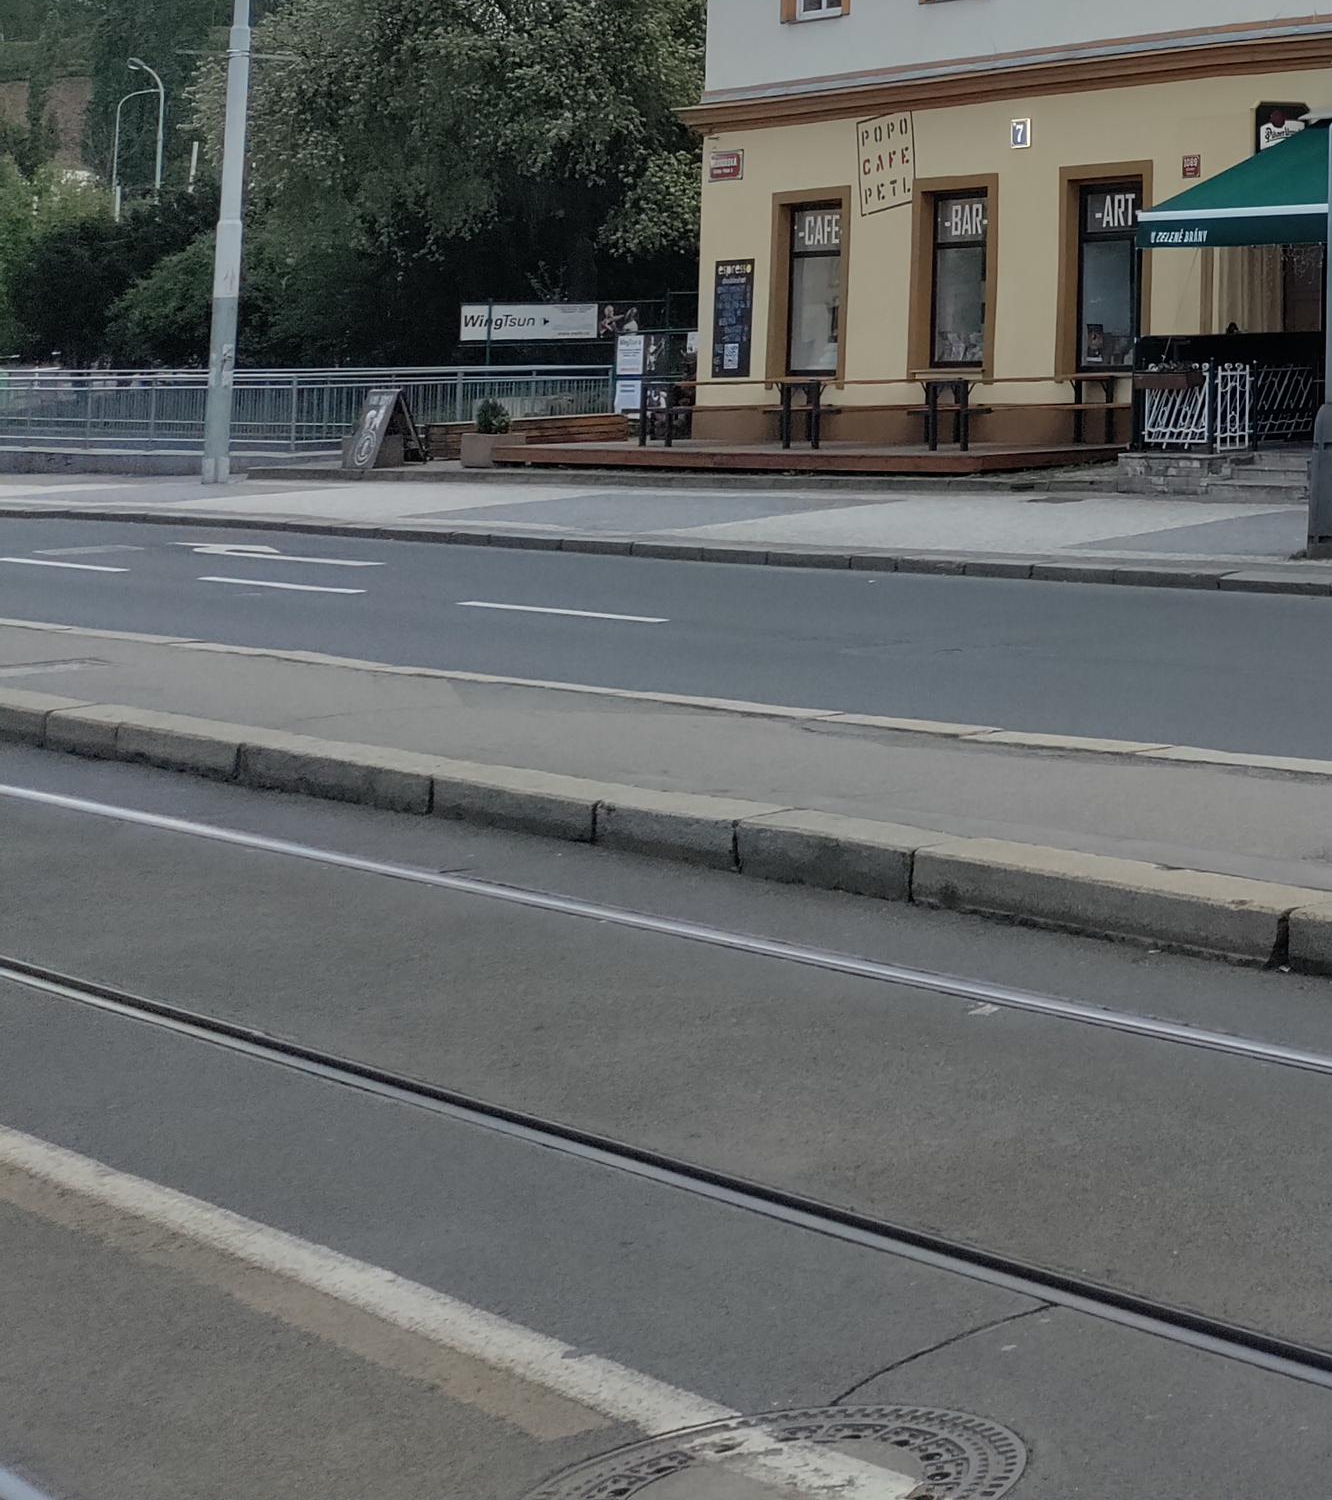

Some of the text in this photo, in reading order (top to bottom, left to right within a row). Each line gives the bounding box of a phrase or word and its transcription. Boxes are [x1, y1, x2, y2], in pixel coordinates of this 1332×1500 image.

[861, 117, 908, 146] POPO
[1015, 124, 1024, 143] 7
[862, 146, 910, 176] CAFE
[864, 177, 911, 205] PETL
[1150, 227, 1208, 244] U ZELENÉ BRÁNY
[718, 264, 752, 277] espresso
[464, 314, 536, 331] WingTsun
